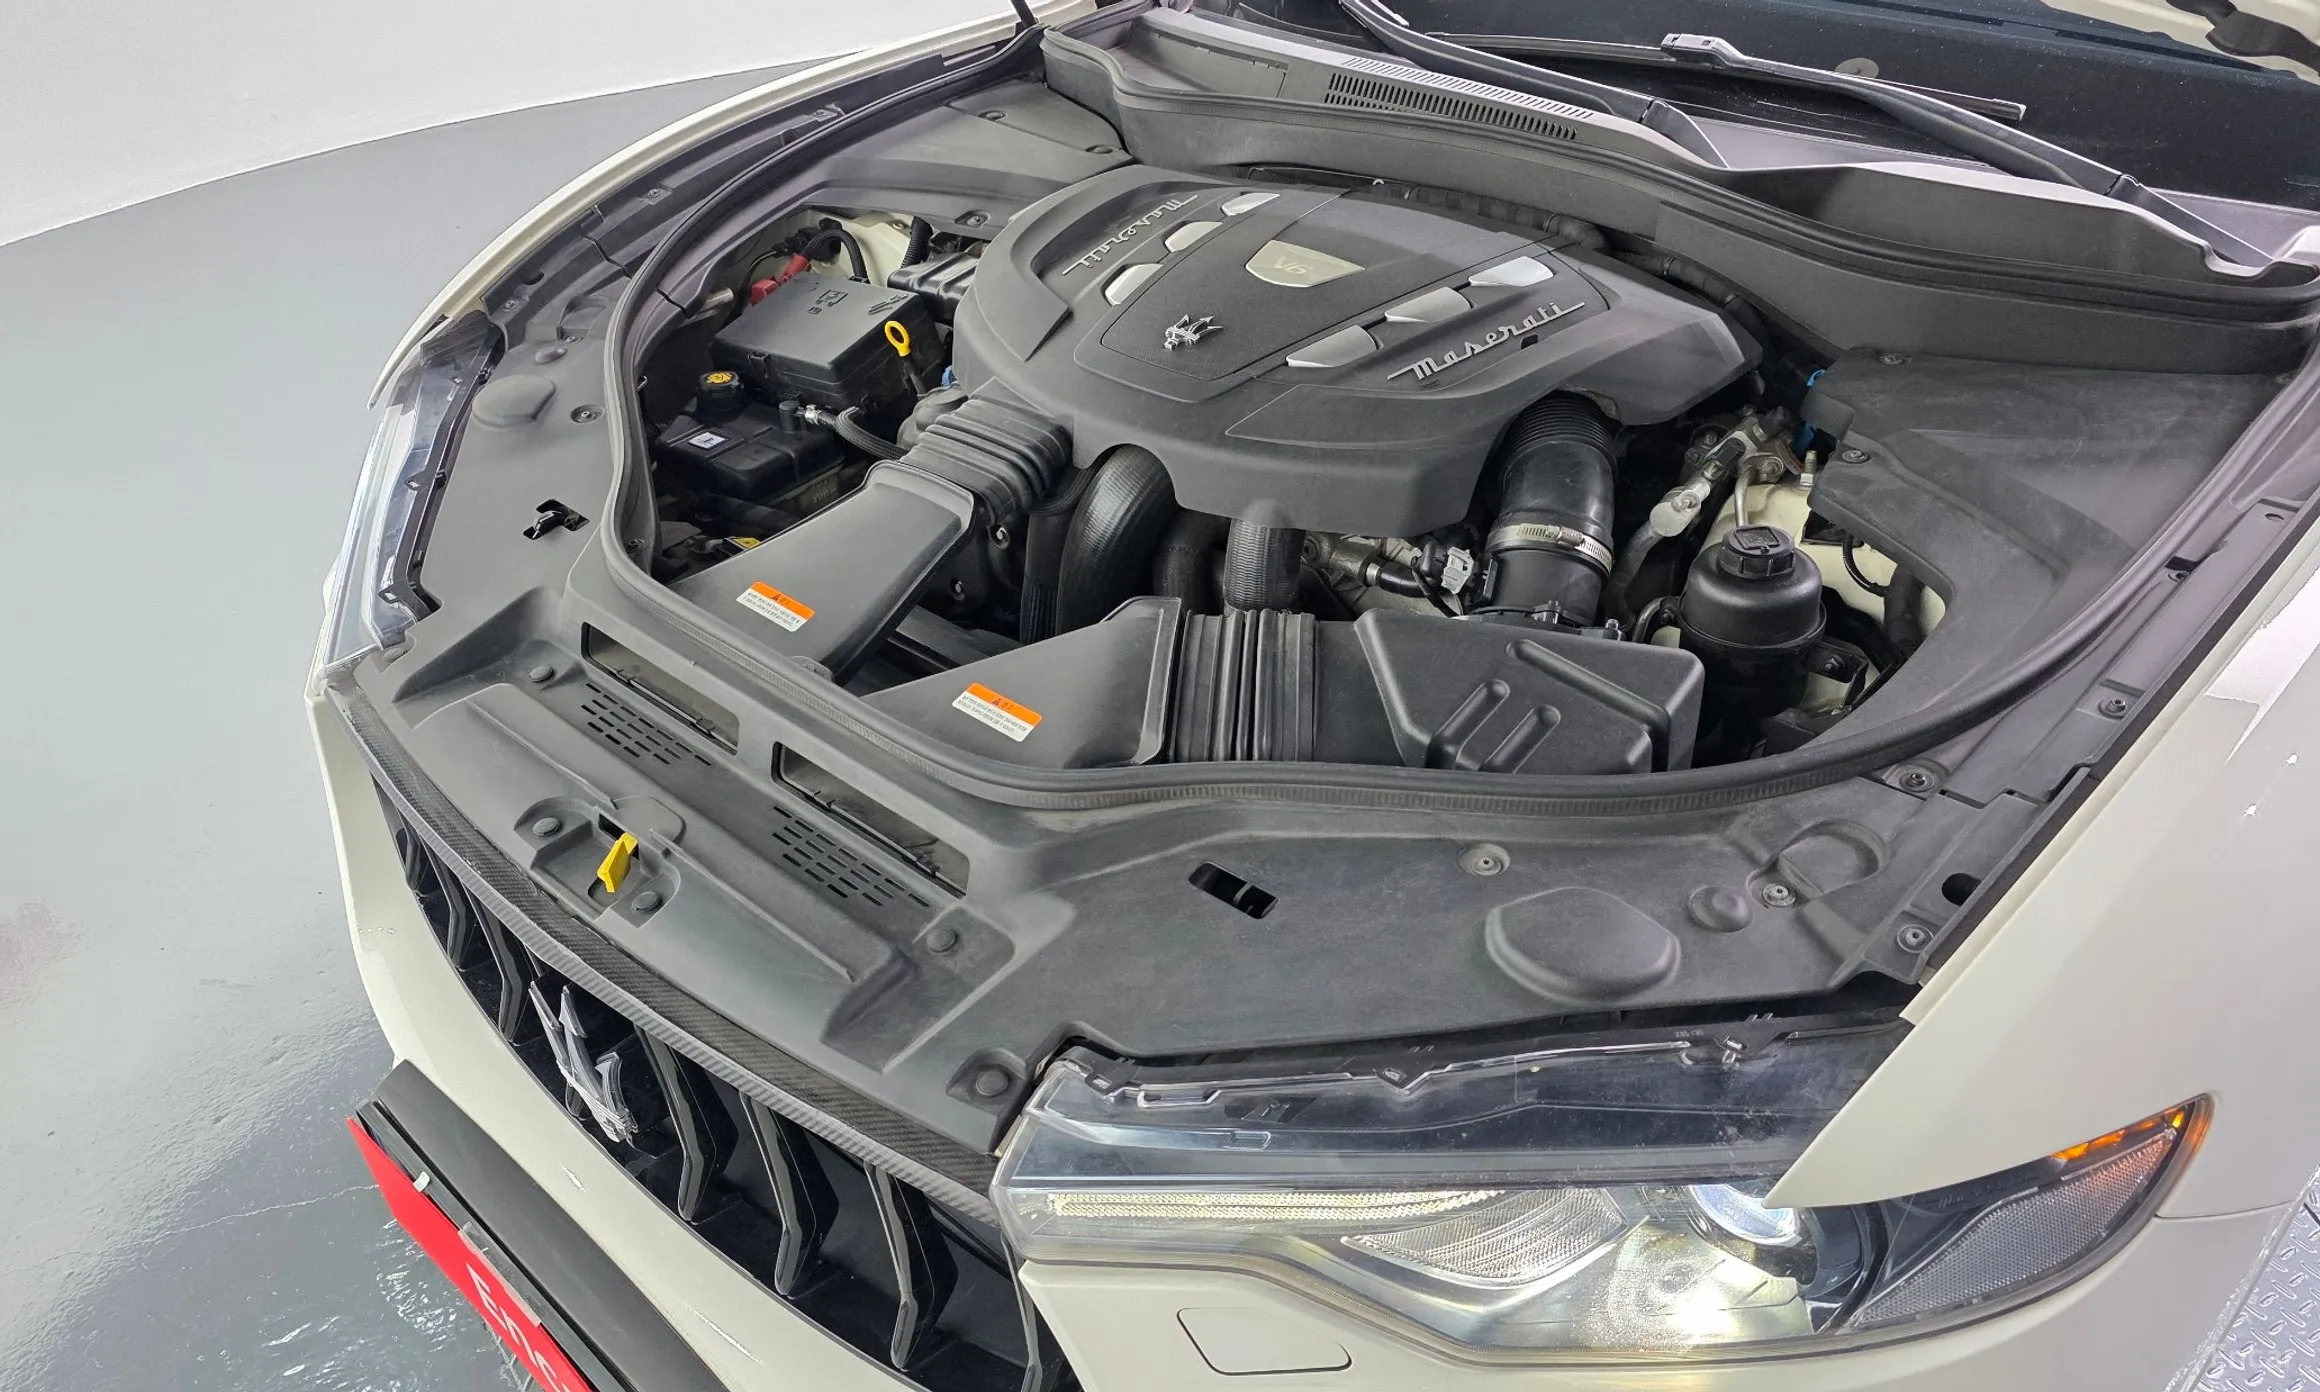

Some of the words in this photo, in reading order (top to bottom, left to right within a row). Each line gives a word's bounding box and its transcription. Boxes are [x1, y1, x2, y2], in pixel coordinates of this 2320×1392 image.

[1062, 194, 1198, 275] Maserati
[1274, 255, 1314, 275] V6
[1386, 302, 1586, 380] Maserati
[466, 1262, 571, 1392] Enc
